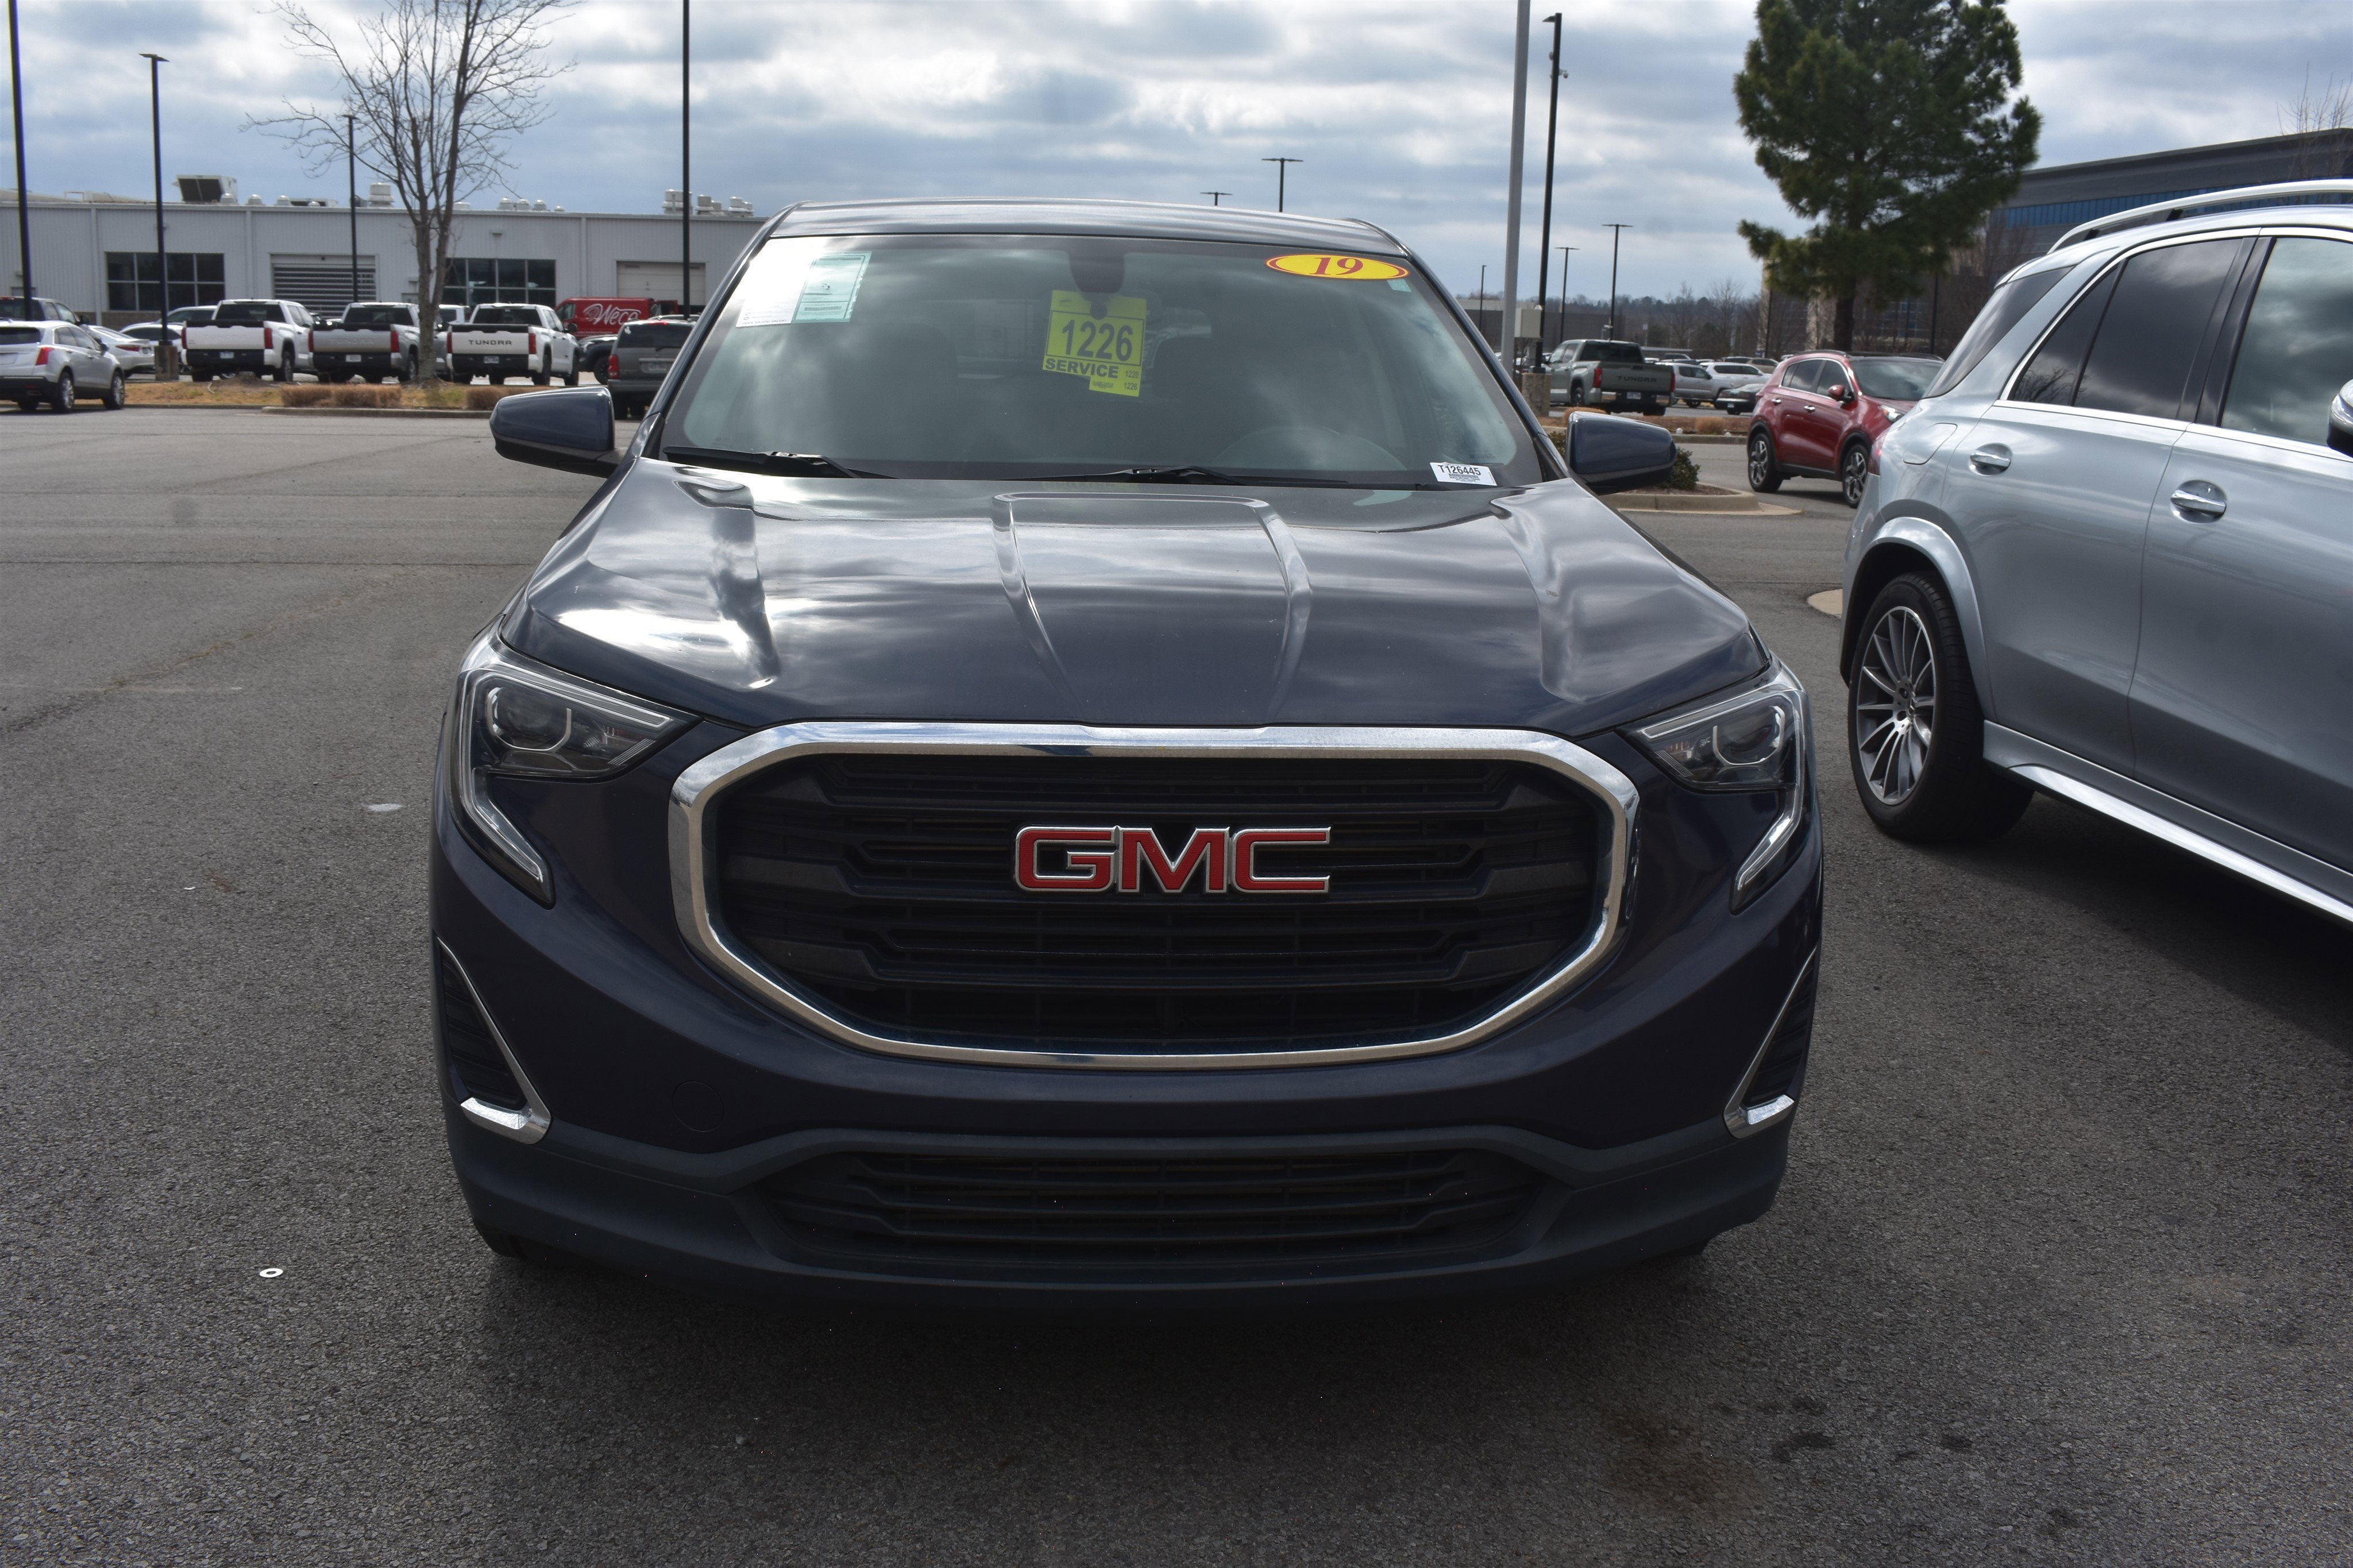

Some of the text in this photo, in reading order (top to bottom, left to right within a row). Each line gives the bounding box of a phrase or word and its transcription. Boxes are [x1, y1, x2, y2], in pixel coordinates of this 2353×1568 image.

[1309, 257, 1364, 275] 19
[1062, 319, 1133, 362] 1226
[1045, 358, 1119, 379] SERVICE
[1125, 370, 1139, 379] 1226
[1124, 381, 1137, 391] 1226
[1438, 465, 1482, 476] T126445
[1015, 825, 1332, 893] GMC
